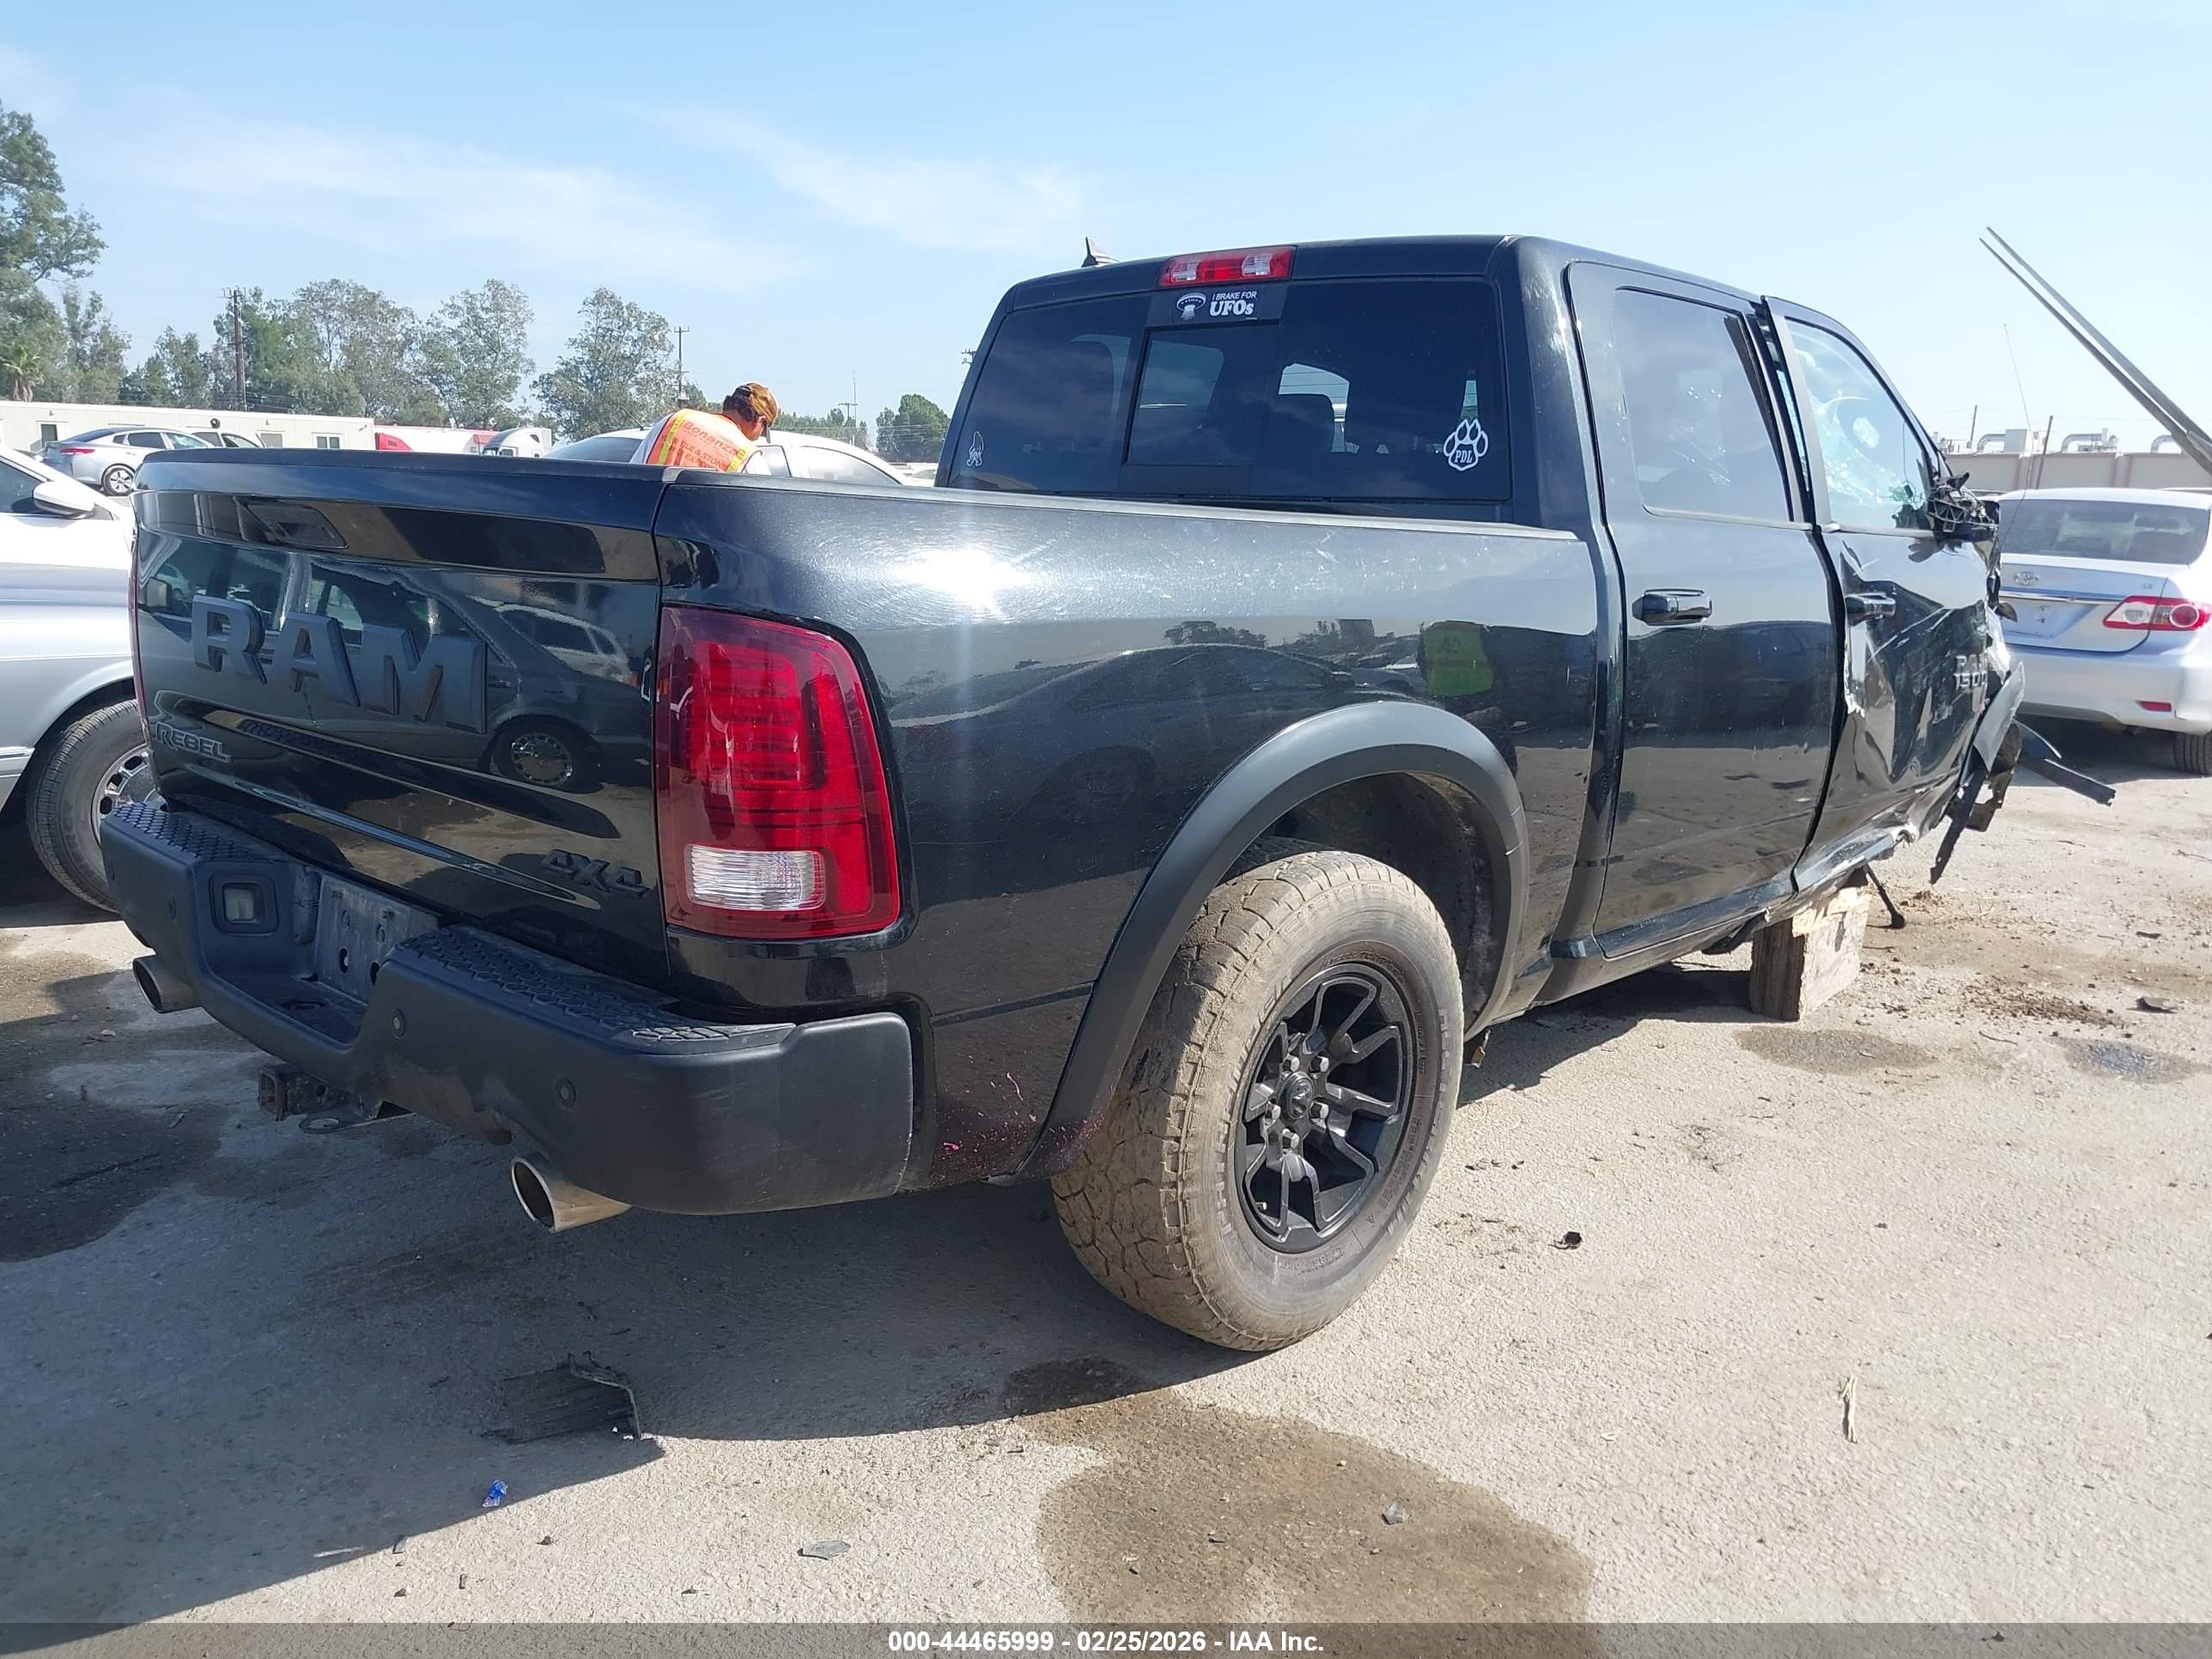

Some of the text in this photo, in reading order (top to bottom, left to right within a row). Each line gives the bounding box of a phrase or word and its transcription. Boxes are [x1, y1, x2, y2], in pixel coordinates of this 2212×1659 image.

[1216, 292, 1240, 301] BRAKE
[1209, 300, 1254, 316] UFOs
[683, 421, 738, 456] Bonanza
[1454, 449, 1473, 464] PDL
[191, 594, 487, 735] RAM
[1954, 671, 1989, 690] 1500
[156, 721, 232, 763] REBEL
